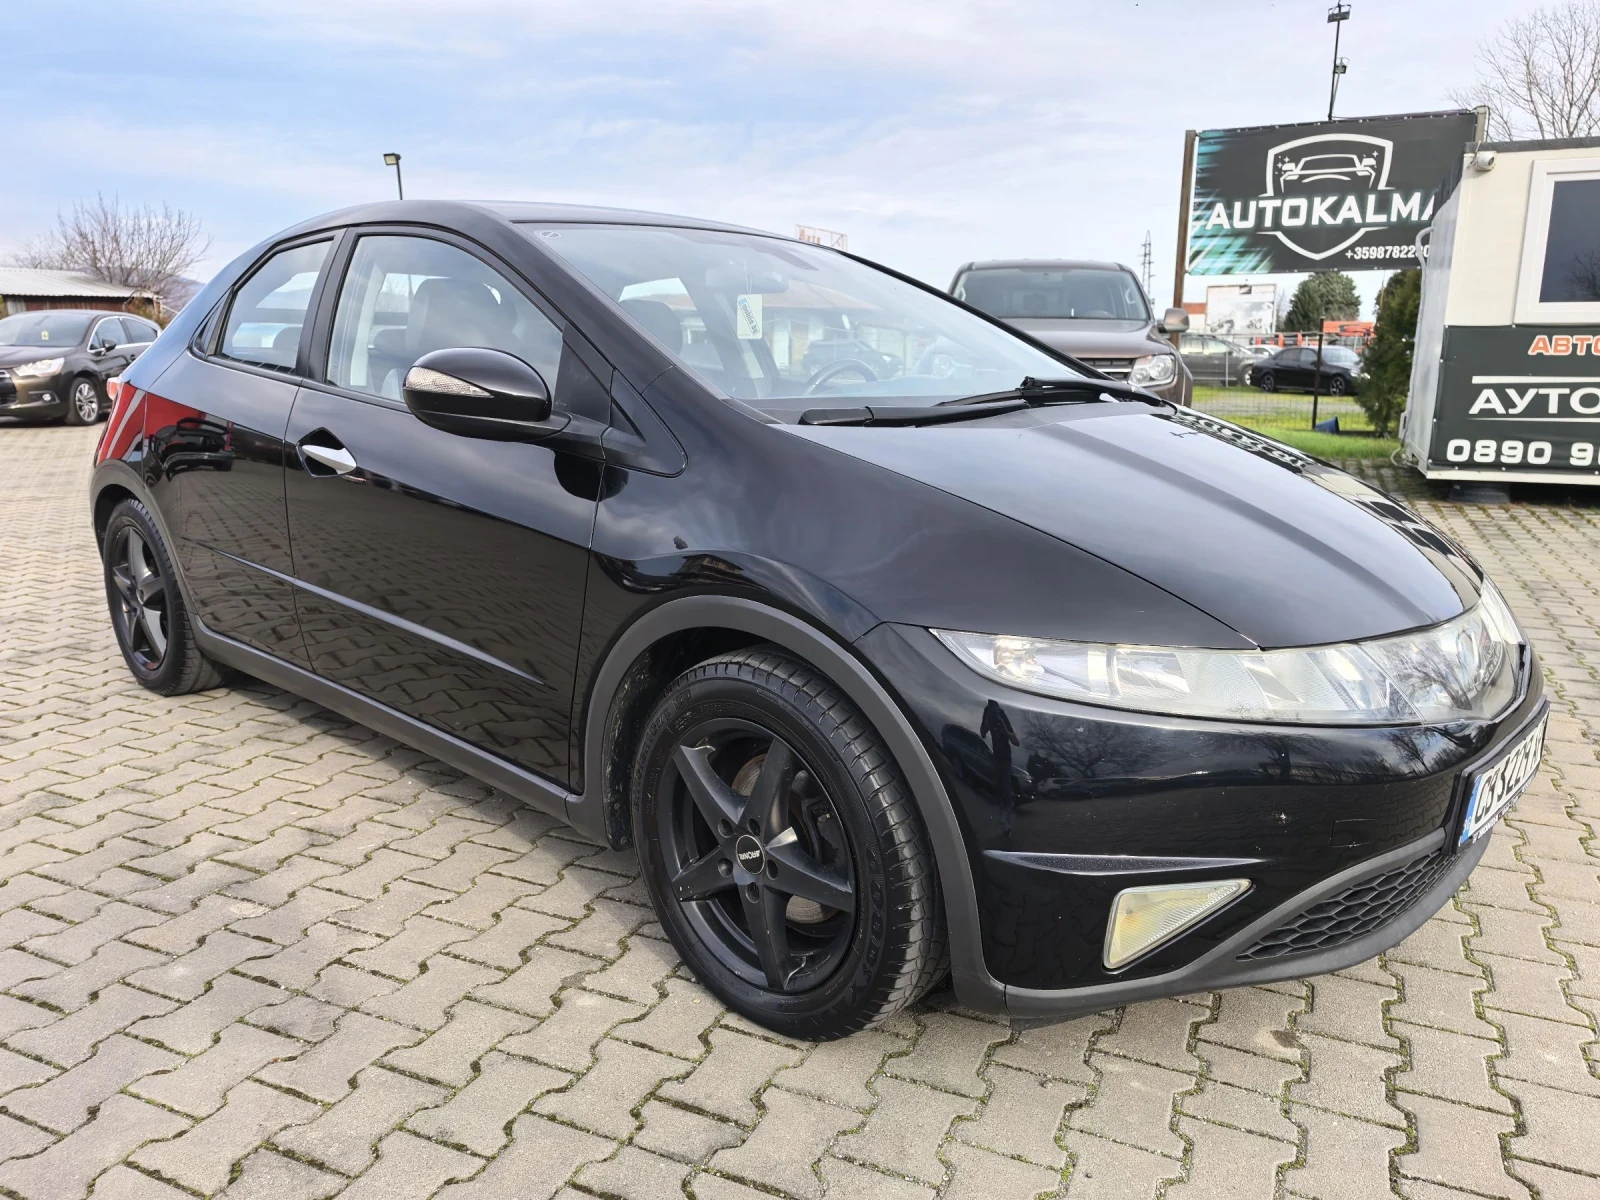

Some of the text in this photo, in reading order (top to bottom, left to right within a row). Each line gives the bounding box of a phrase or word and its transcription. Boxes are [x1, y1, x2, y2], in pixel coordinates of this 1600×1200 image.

[1345, 245, 1430, 260] +359878220
[1468, 387, 1600, 415] АУТО
[1446, 438, 1600, 467] 0890 9
